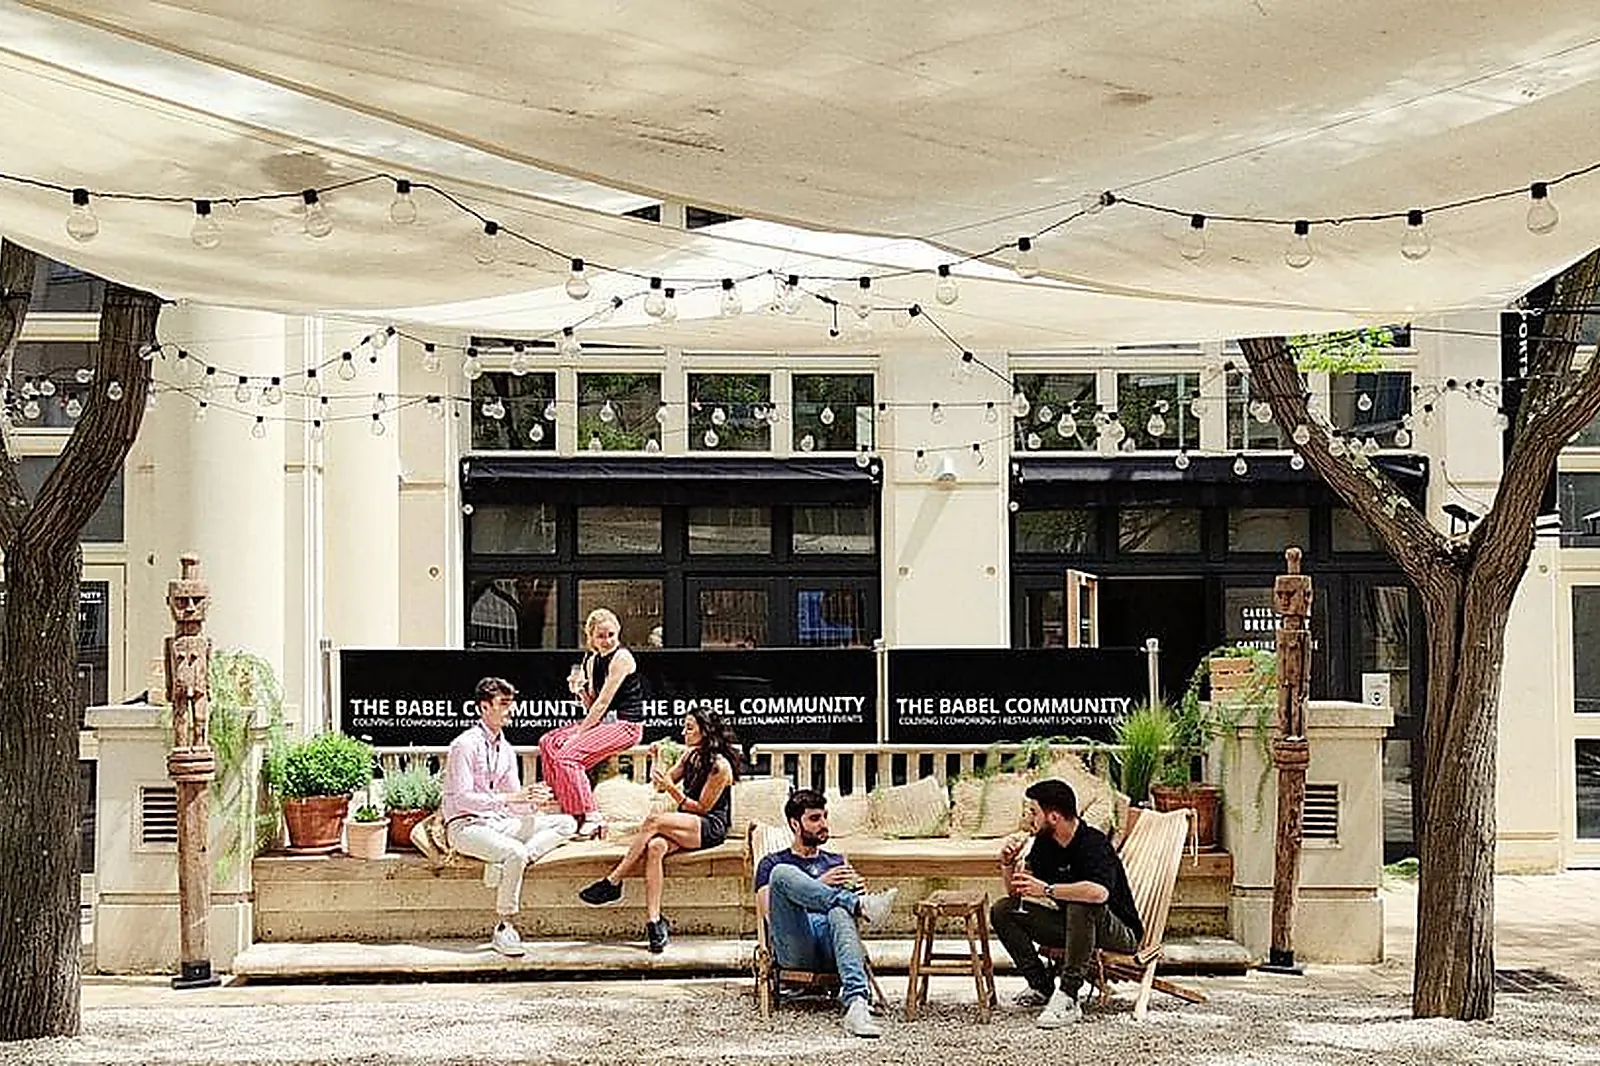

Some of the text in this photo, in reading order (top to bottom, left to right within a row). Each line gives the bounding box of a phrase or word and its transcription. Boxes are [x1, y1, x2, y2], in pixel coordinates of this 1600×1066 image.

[350, 699, 589, 717] THE BABEL CMUNITY
[642, 696, 866, 716] HE BABEL COMMUNITY
[896, 697, 1131, 715] THE BABEL COMMUNITY
[400, 718, 454, 728] COWORKING
[520, 719, 552, 728] SPORTS
